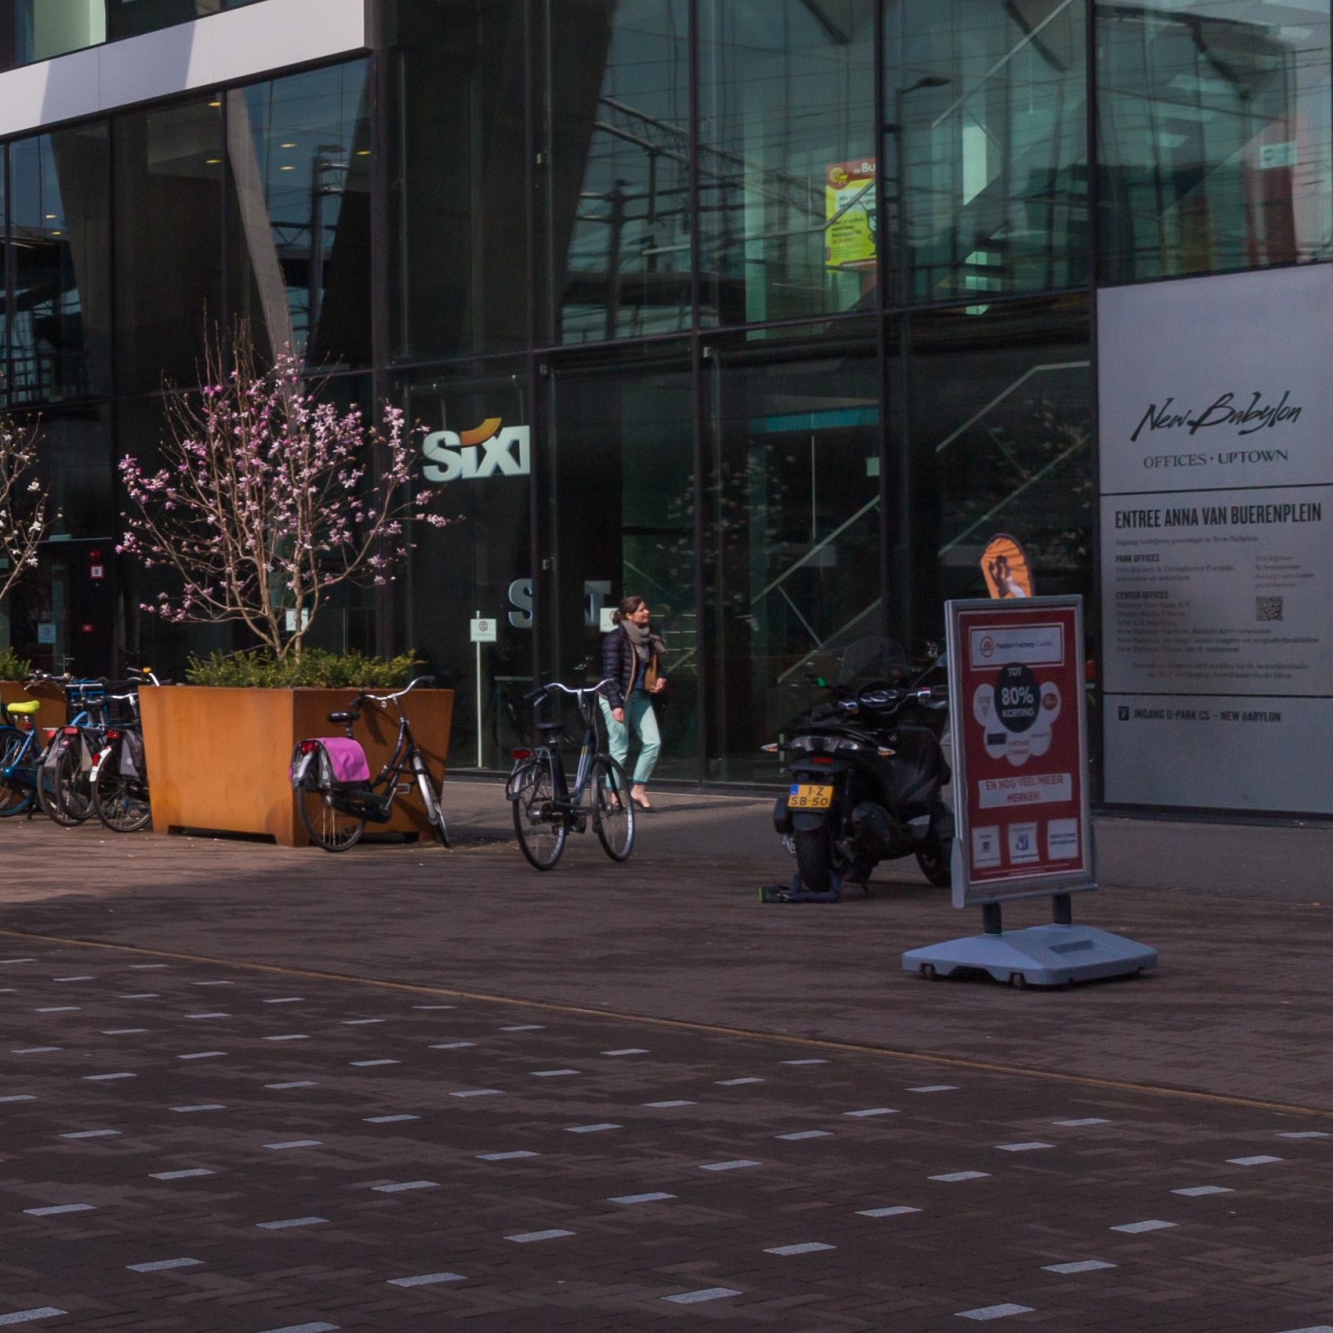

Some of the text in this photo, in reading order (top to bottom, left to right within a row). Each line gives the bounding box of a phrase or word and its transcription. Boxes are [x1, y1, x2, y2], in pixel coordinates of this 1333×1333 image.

[1131, 390, 1303, 442] New Babylon
[1143, 449, 1289, 469] OFFICES UPTOWN
[1115, 502, 1322, 529] ENTREE ANNA VAN BUERENPLEIN
[1115, 553, 1160, 563] PARK OFFICES
[1007, 667, 1022, 676] TOT
[1001, 685, 1034, 706] 80%
[1133, 708, 1165, 720] INGANG
[1220, 711, 1240, 722] NEW
[1241, 711, 1282, 722] BABYLON
[985, 781, 997, 791] EN
[999, 779, 1016, 789] NOG
[1038, 774, 1064, 786] MEER
[790, 796, 829, 806] SB-50
